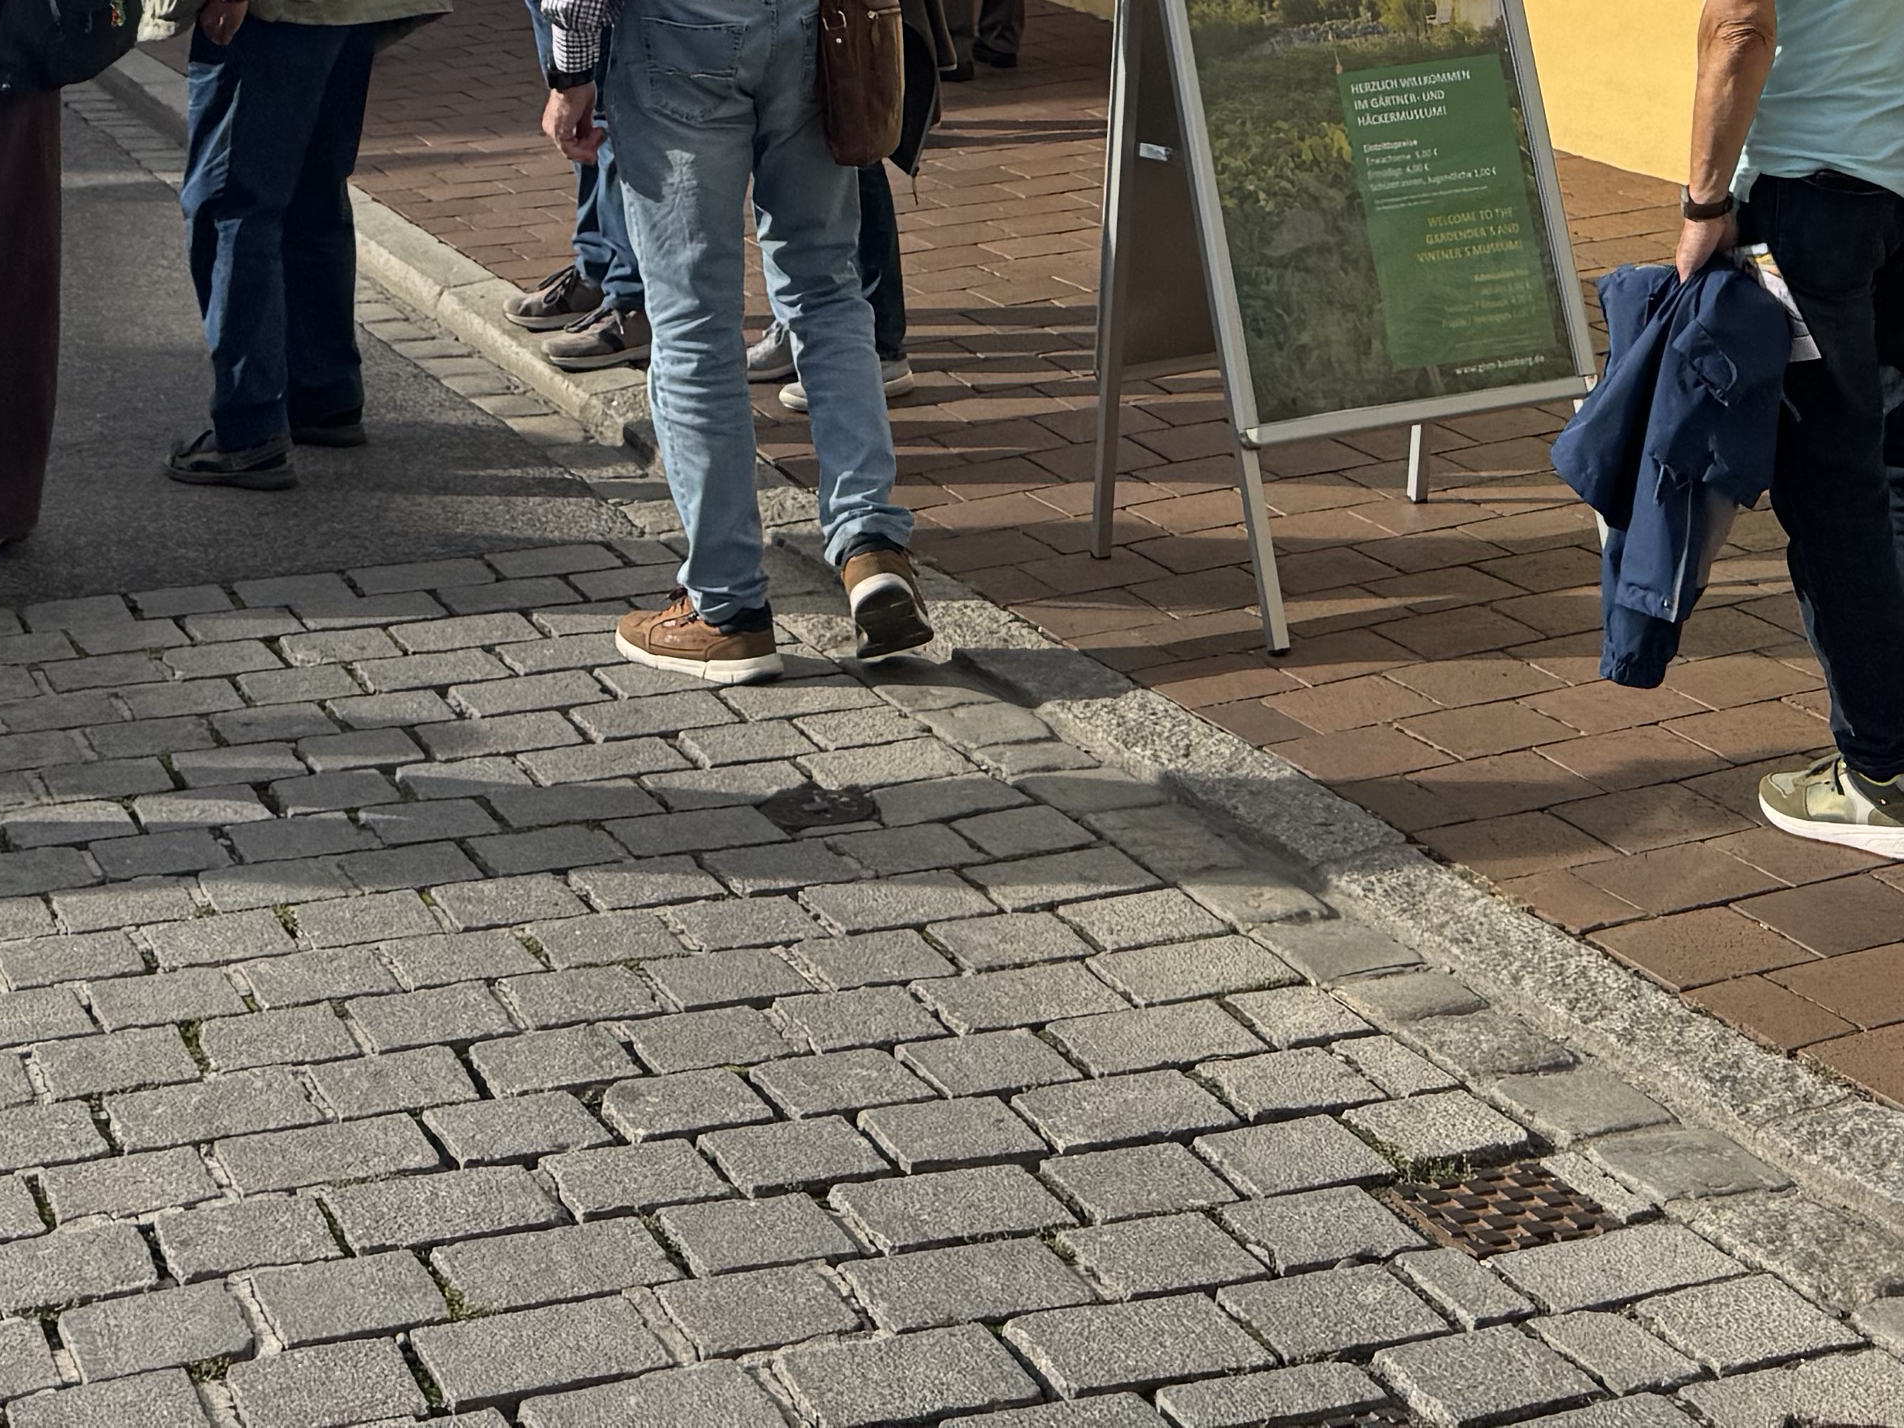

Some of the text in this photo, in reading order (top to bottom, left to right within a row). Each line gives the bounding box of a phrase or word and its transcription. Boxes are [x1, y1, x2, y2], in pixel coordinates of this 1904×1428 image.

[1350, 69, 1471, 95] HERZLICH WILLKOMMEN
[1354, 99, 1369, 110] IM
[1422, 89, 1445, 101] UND
[1426, 207, 1513, 227] WELCOME TO THE
[1497, 223, 1520, 234] AND
